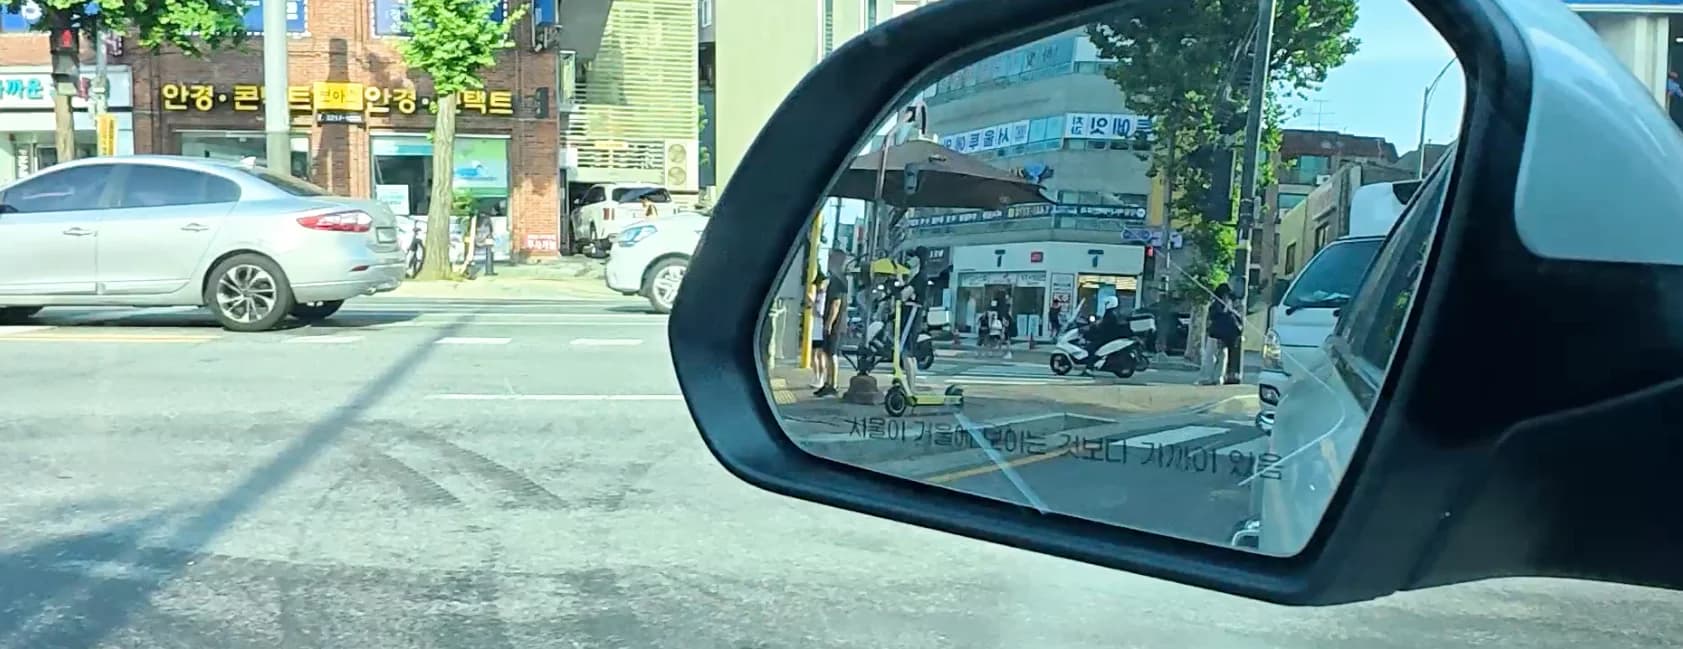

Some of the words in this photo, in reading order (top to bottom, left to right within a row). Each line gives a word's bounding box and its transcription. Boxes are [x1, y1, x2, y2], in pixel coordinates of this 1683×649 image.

[162, 84, 313, 111] 안경·콘트
[364, 85, 513, 115] 안경·택트
[913, 420, 974, 450] 거울에
[982, 428, 1047, 455] 보이는
[1057, 432, 1128, 465] 것보다
[1140, 441, 1217, 475] 가까이
[1228, 449, 1283, 481] 있음
